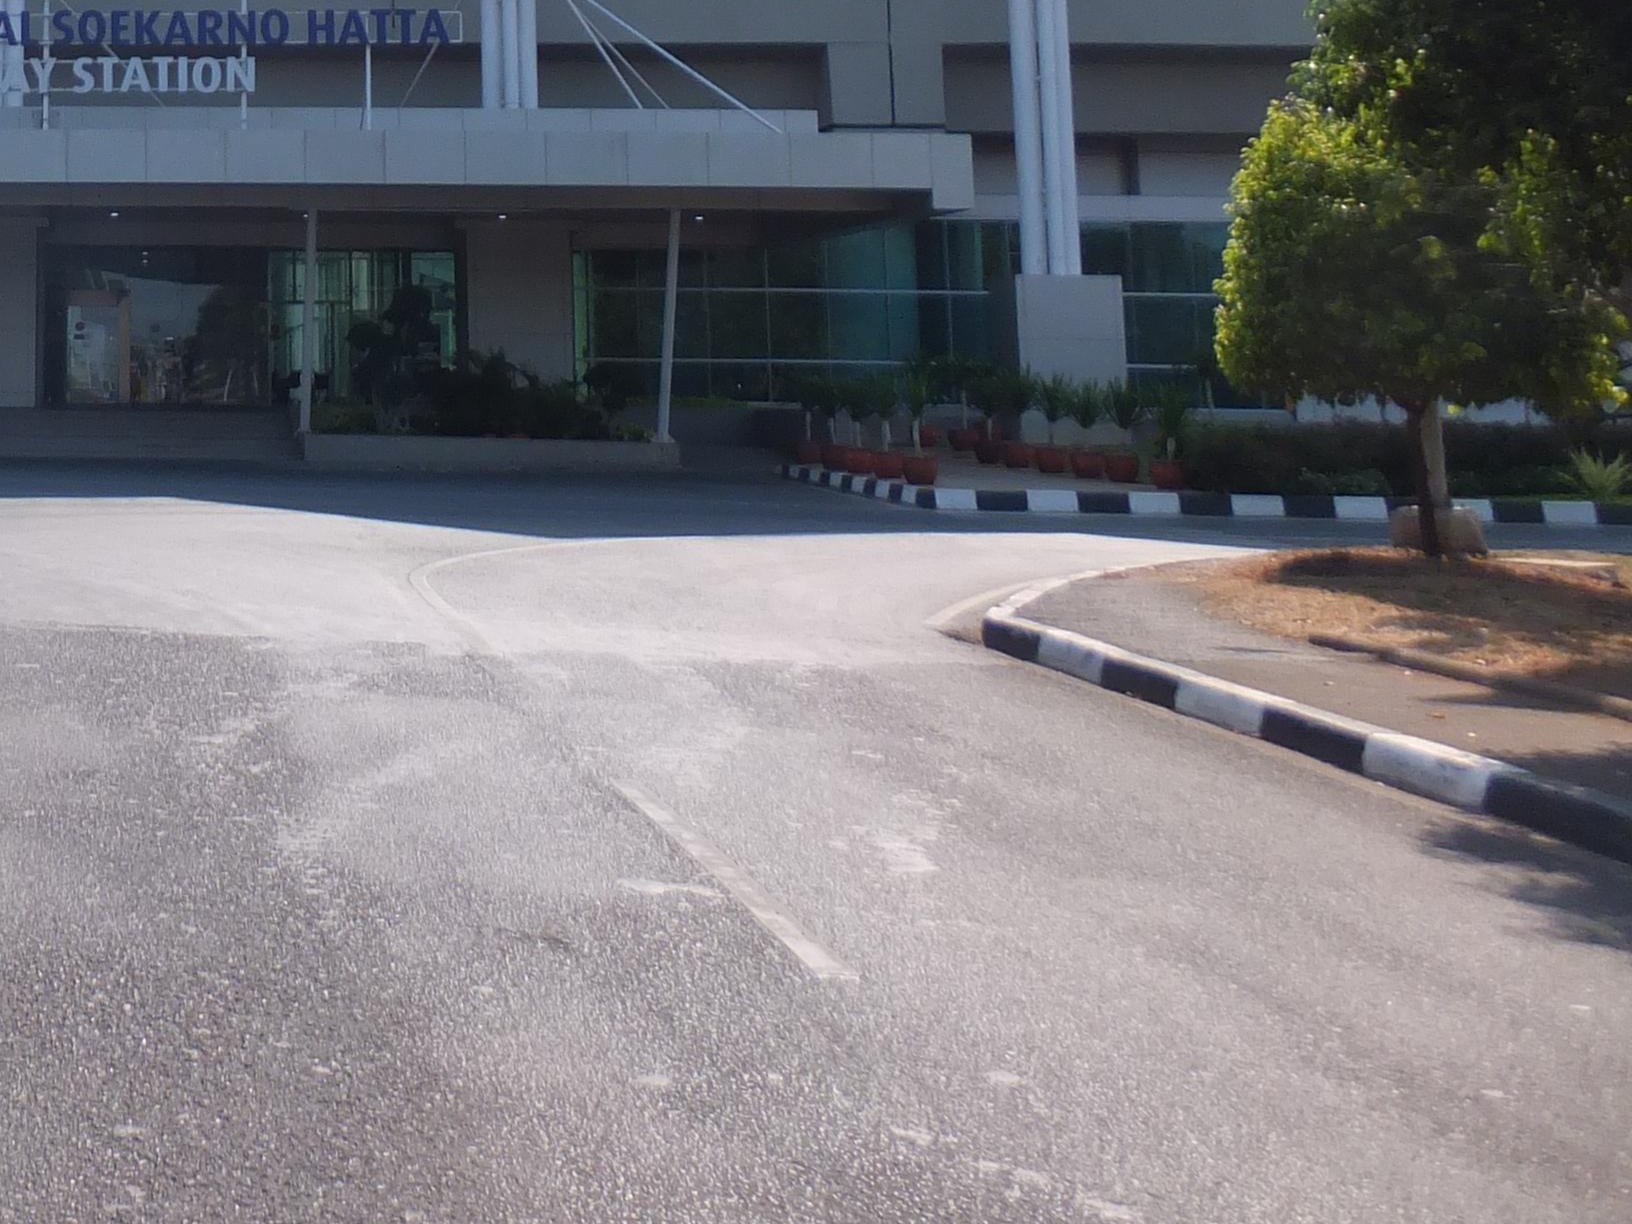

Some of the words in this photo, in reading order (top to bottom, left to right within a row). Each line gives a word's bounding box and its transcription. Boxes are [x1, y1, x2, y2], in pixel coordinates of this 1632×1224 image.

[52, 8, 289, 46] SOEKARNO
[306, 8, 451, 46] HATTA
[73, 55, 256, 93] STATION
